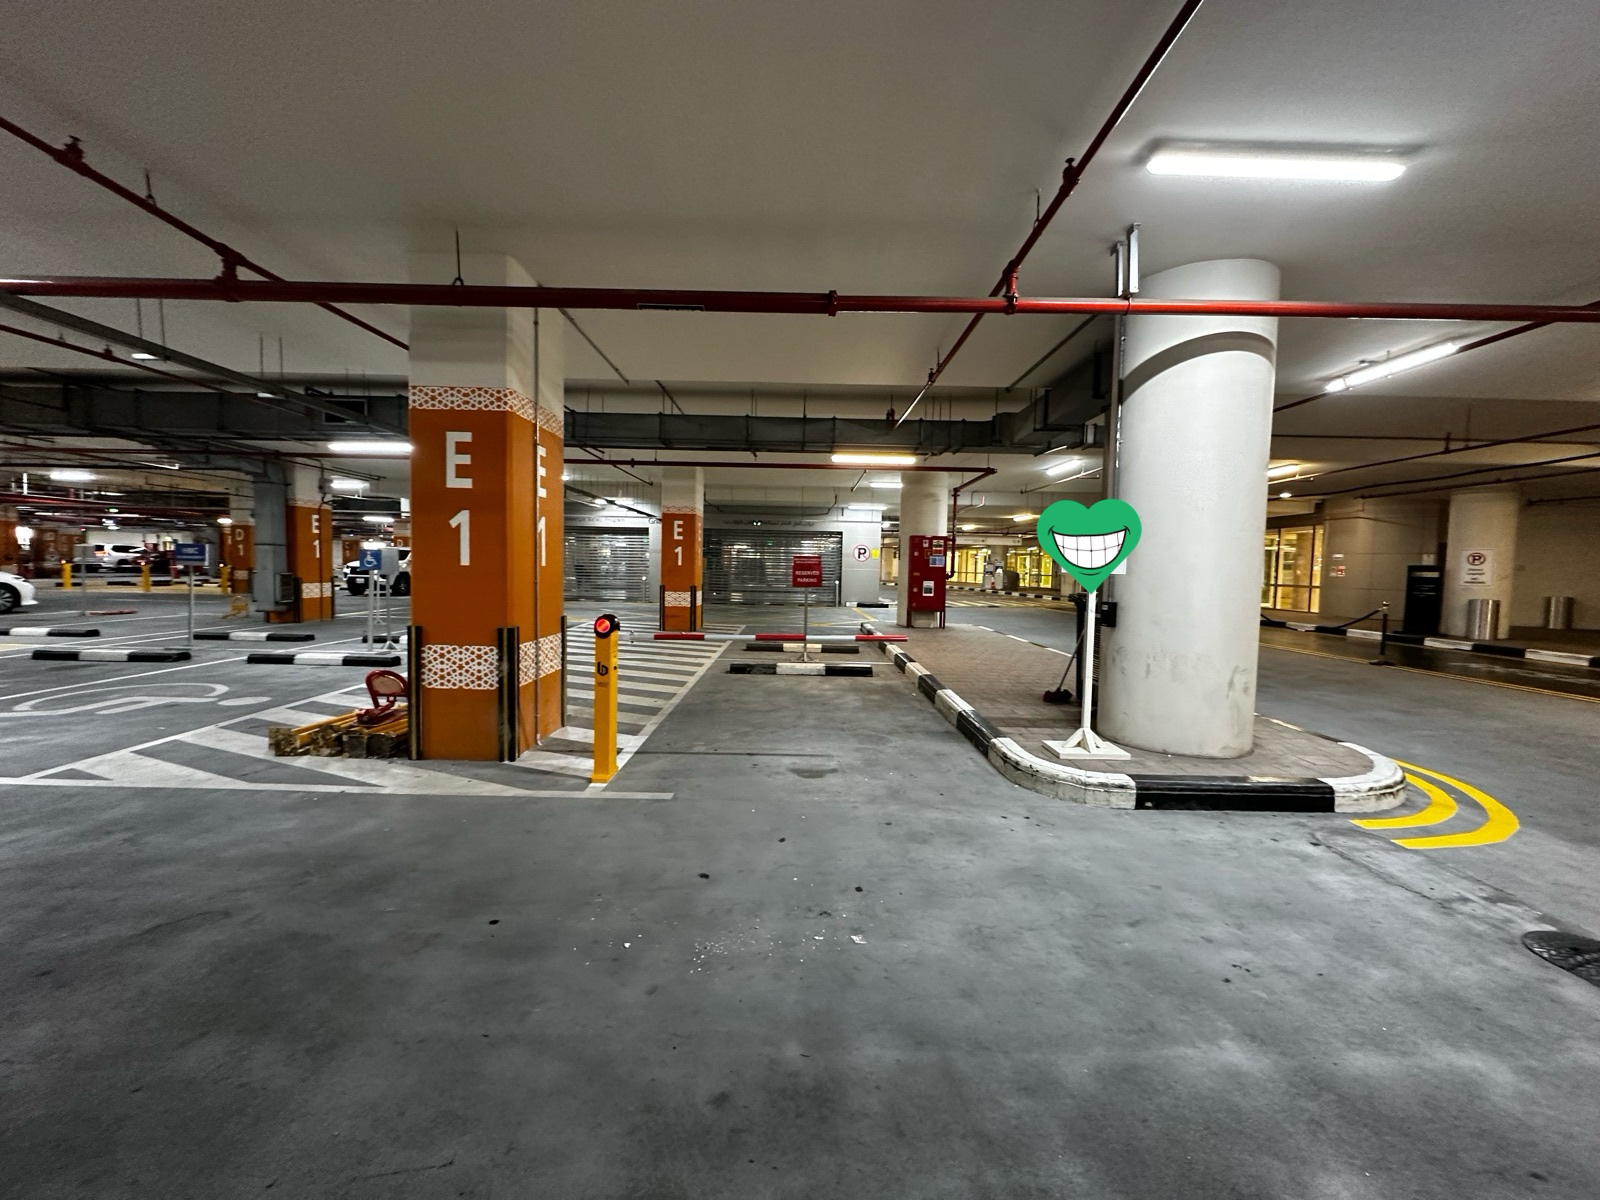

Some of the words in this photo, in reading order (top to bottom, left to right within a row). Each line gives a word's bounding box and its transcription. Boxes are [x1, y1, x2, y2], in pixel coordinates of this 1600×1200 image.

[446, 431, 473, 489] E
[537, 445, 547, 499] E
[312, 514, 320, 534] E
[673, 520, 684, 541] E
[235, 528, 245, 541] D
[449, 510, 470, 566] 1
[537, 516, 546, 567] 1
[238, 544, 244, 556] 1
[312, 539, 320, 559] 1
[674, 546, 683, 566] 1
